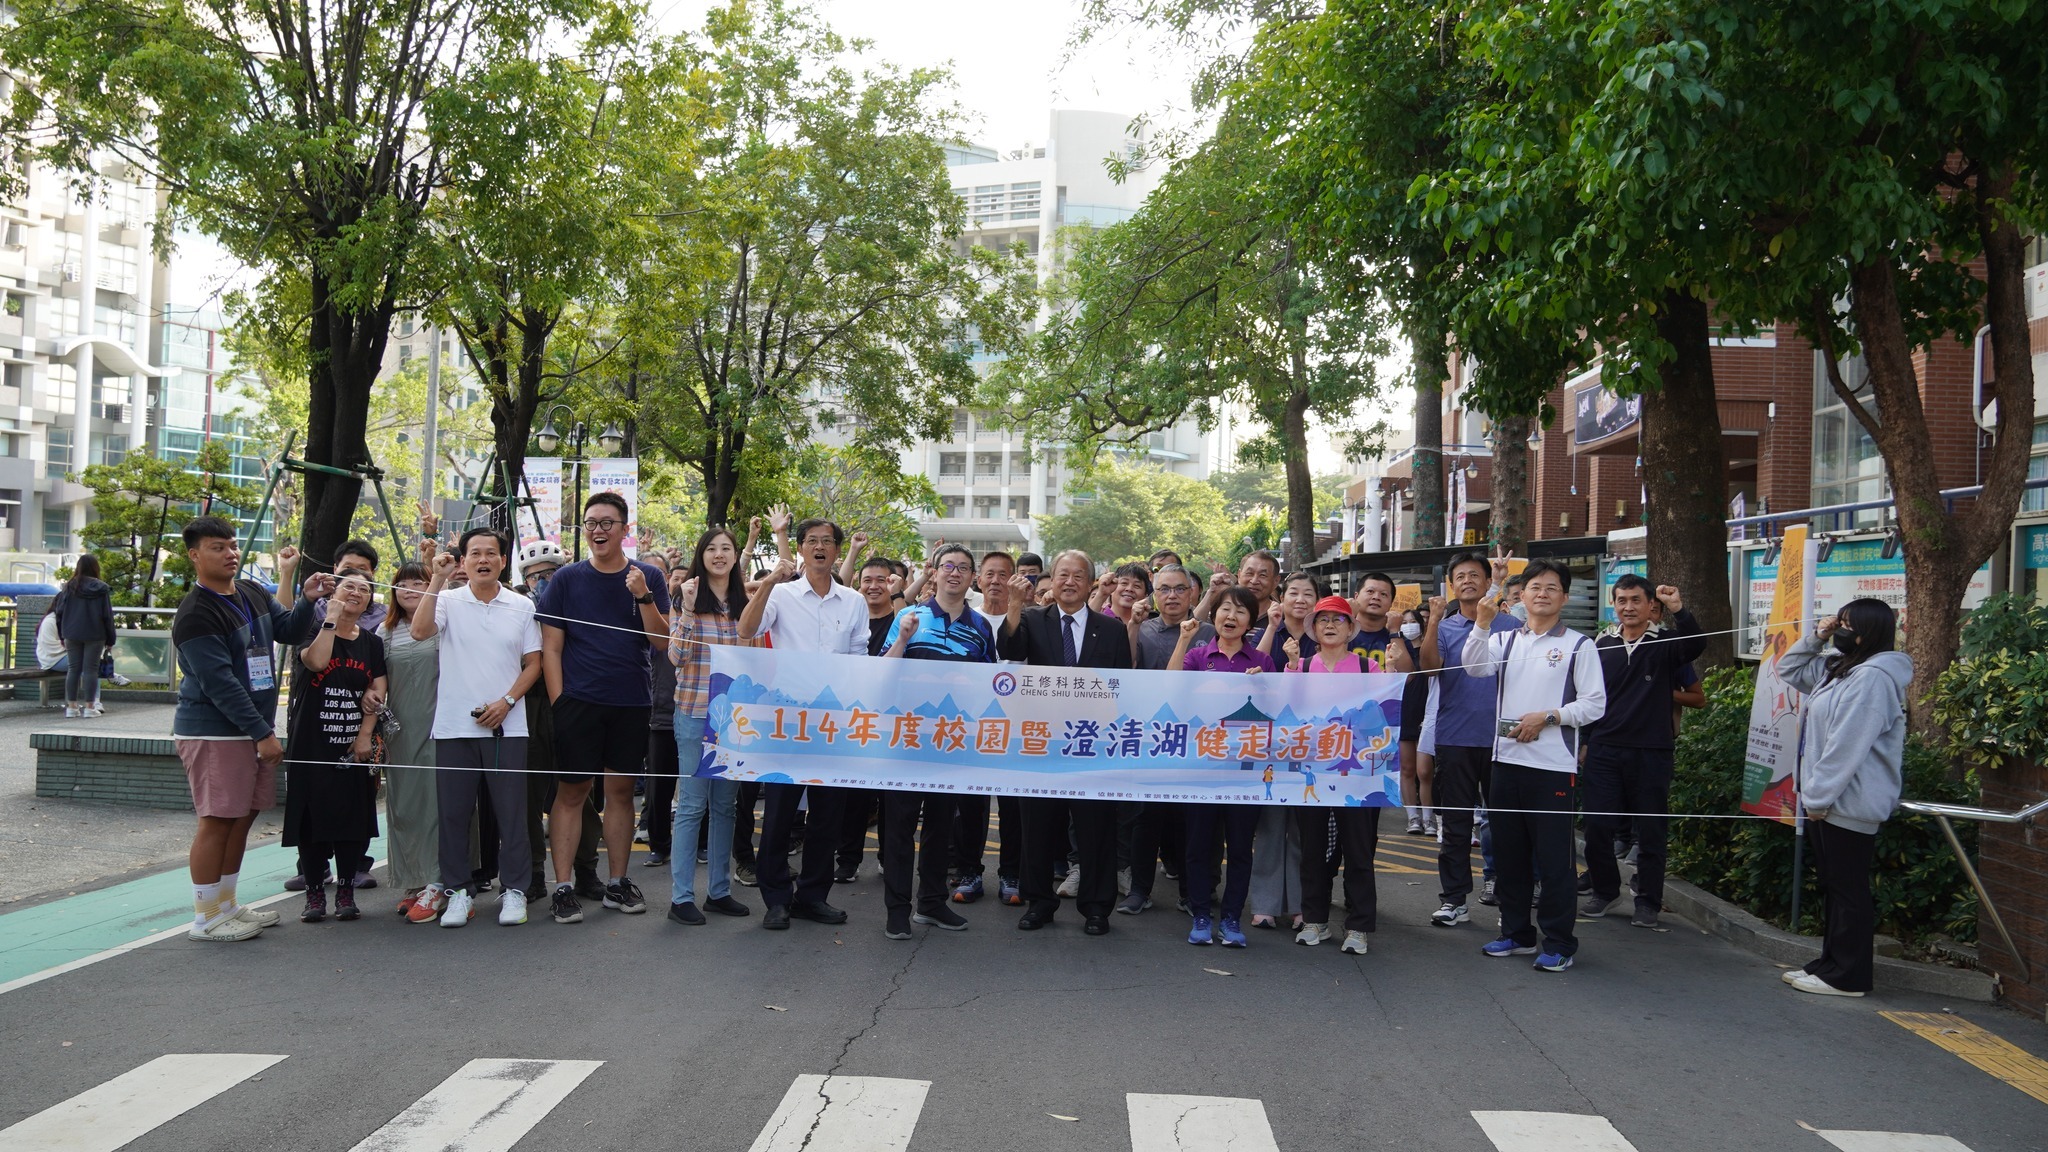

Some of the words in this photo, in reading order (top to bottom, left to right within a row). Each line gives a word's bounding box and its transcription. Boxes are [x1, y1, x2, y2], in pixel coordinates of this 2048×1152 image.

[2032, 532, 2048, 552] 高
[1021, 675, 1120, 691] 正修科技大學
[1021, 688, 1048, 697] CHENG
[1051, 690, 1071, 698] SHIU
[1074, 691, 1120, 699] UNIVERSITY
[324, 700, 339, 708] LOS
[320, 711, 344, 720] SANTA
[323, 724, 343, 732] LONG
